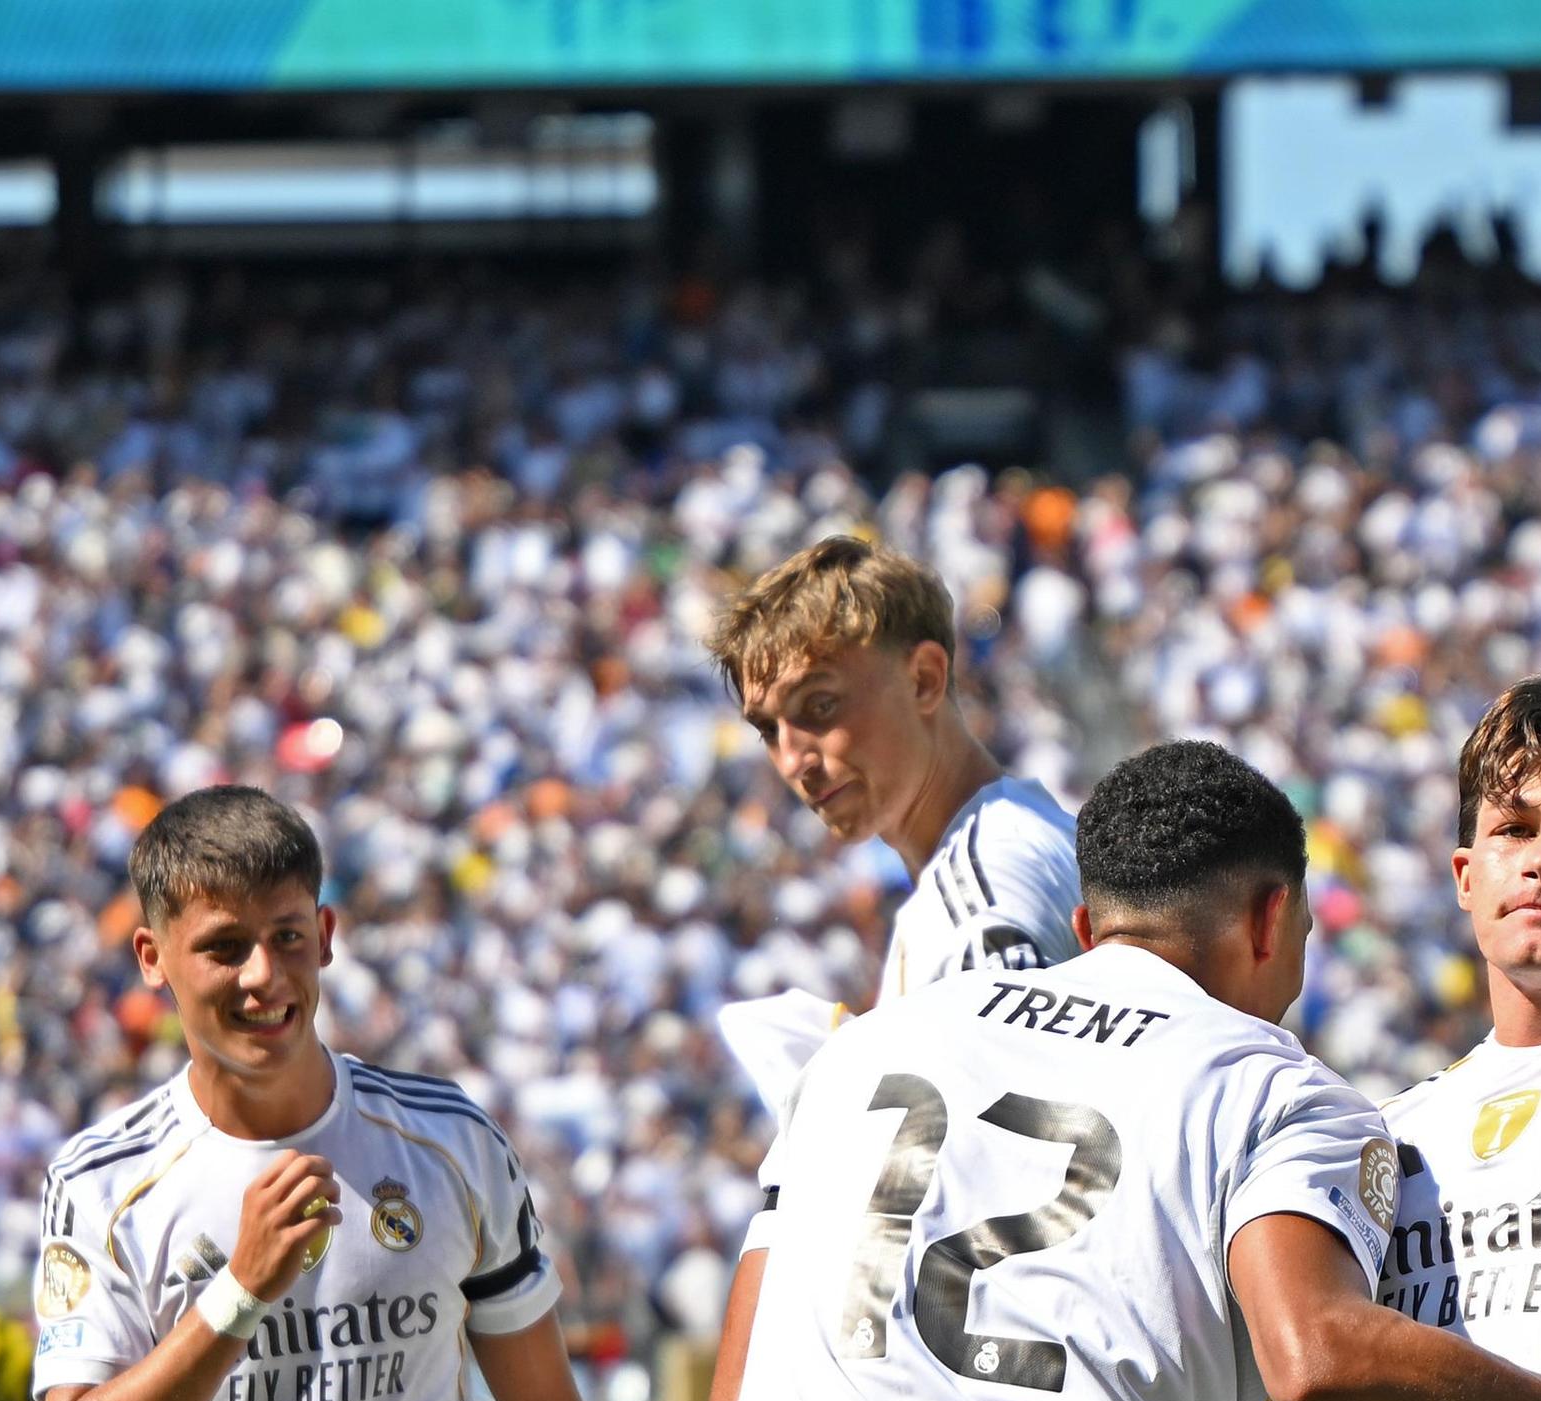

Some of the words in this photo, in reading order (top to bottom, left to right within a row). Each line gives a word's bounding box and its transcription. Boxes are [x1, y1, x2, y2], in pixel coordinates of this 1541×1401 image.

[977, 982, 1171, 1047] TRENT
[839, 1073, 1123, 1393] 12
[1364, 1188, 1387, 1225] FIFA
[237, 1290, 438, 1363] mirates
